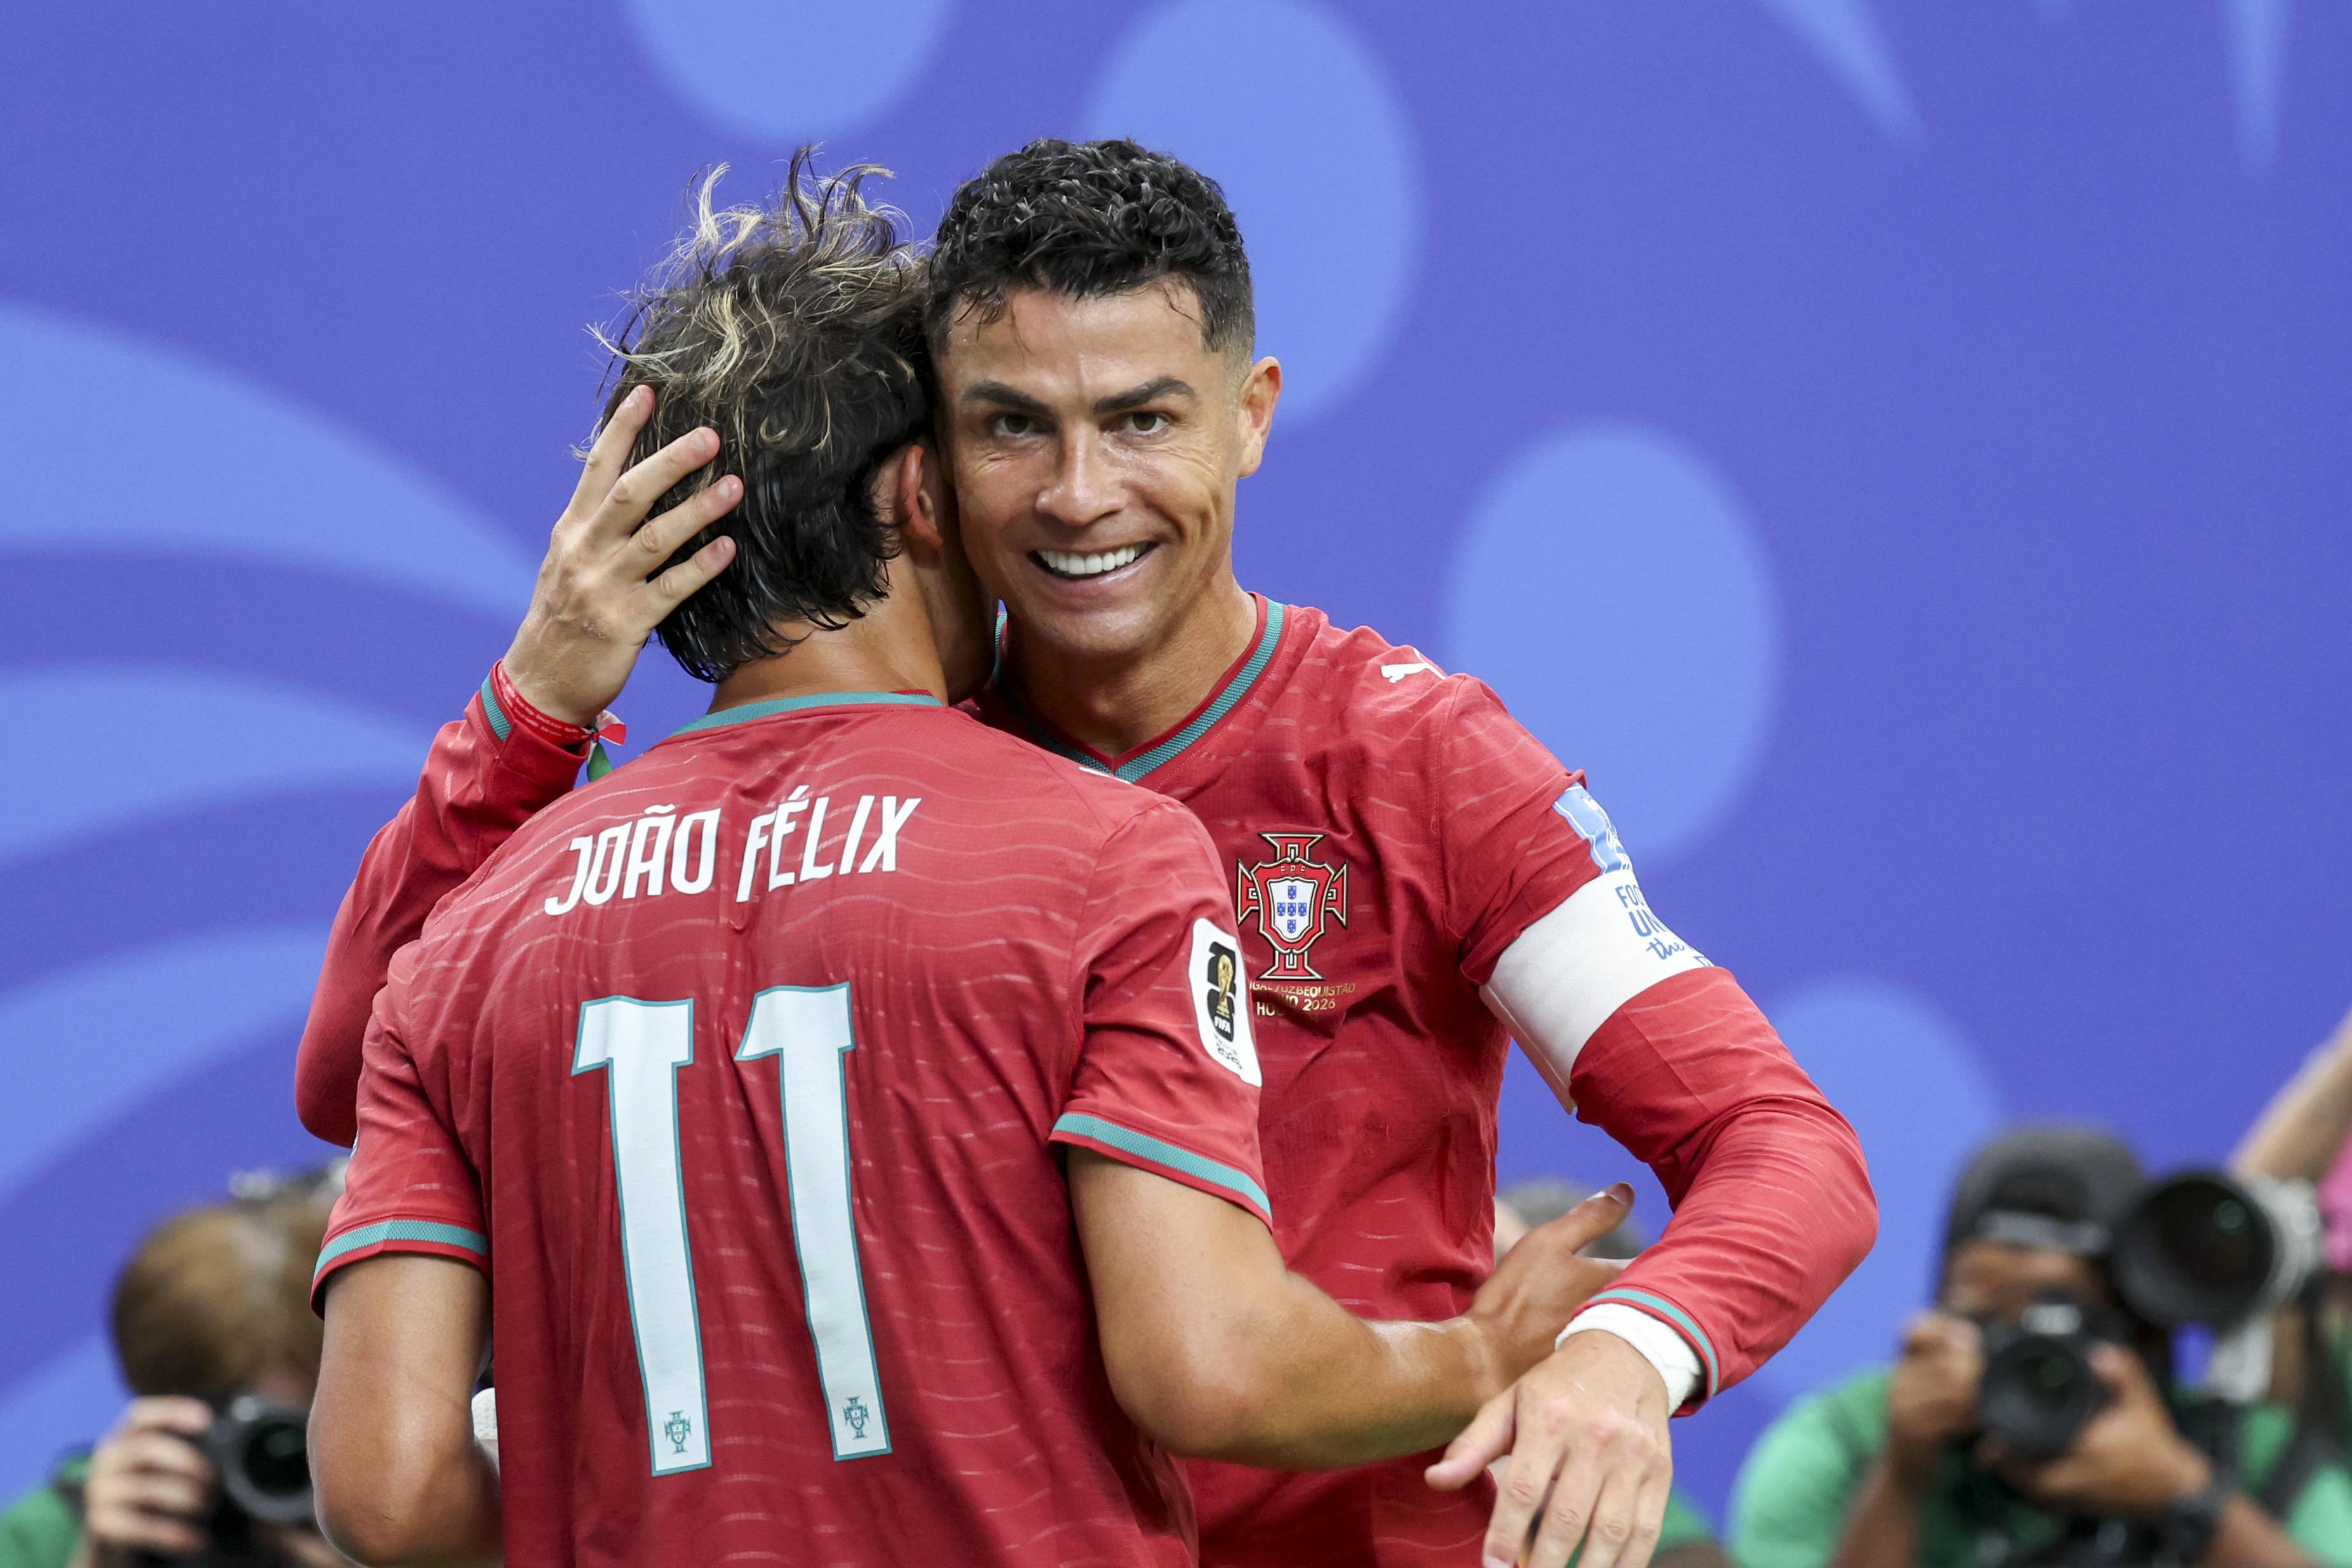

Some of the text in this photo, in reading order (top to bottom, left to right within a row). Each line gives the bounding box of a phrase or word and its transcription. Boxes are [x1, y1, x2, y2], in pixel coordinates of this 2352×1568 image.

[544, 785, 922, 916] JOÃO FÉLIX
[1214, 1015, 1231, 1034] FIFA
[1303, 998, 1336, 1012] 2026
[572, 981, 892, 1477] 11
